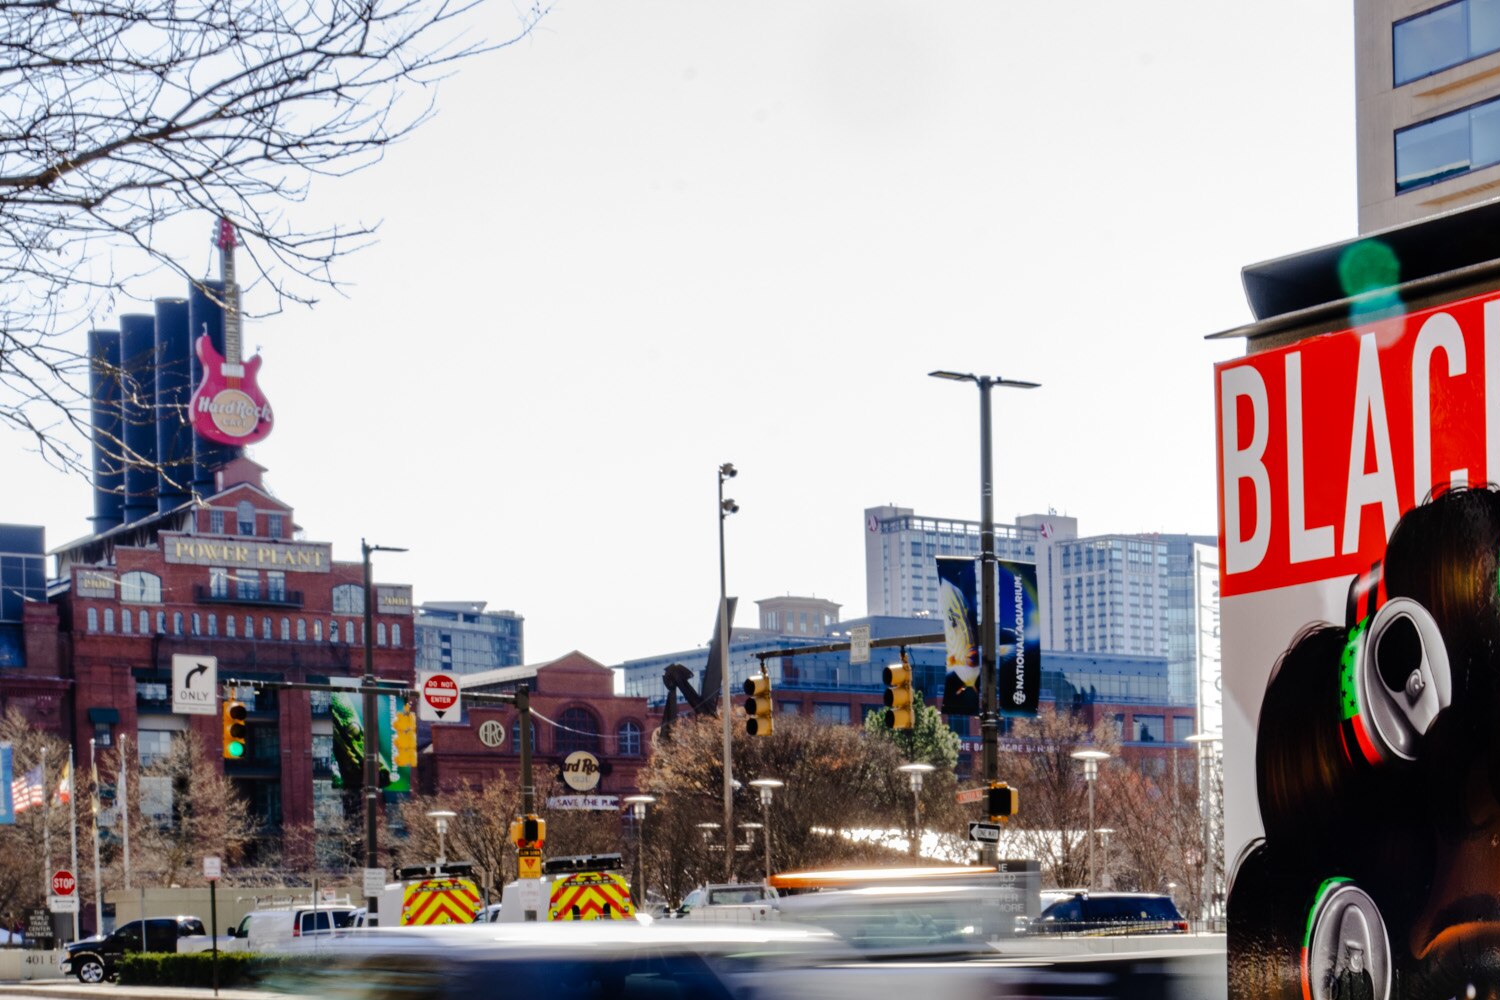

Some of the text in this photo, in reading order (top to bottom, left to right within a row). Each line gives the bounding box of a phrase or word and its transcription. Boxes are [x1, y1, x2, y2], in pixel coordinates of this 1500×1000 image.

[198, 396, 272, 421] Hard Rock
[175, 542, 324, 567] POWER PLANT
[1014, 574, 1025, 690] NATIONAL AQUARIUM
[428, 680, 437, 688] DO
[180, 690, 209, 701] ONLY
[430, 696, 451, 704] ENTER
[959, 742, 970, 751] HE
[563, 758, 581, 772] ard
[53, 877, 75, 889] STOP
[26, 955, 44, 965] 401
